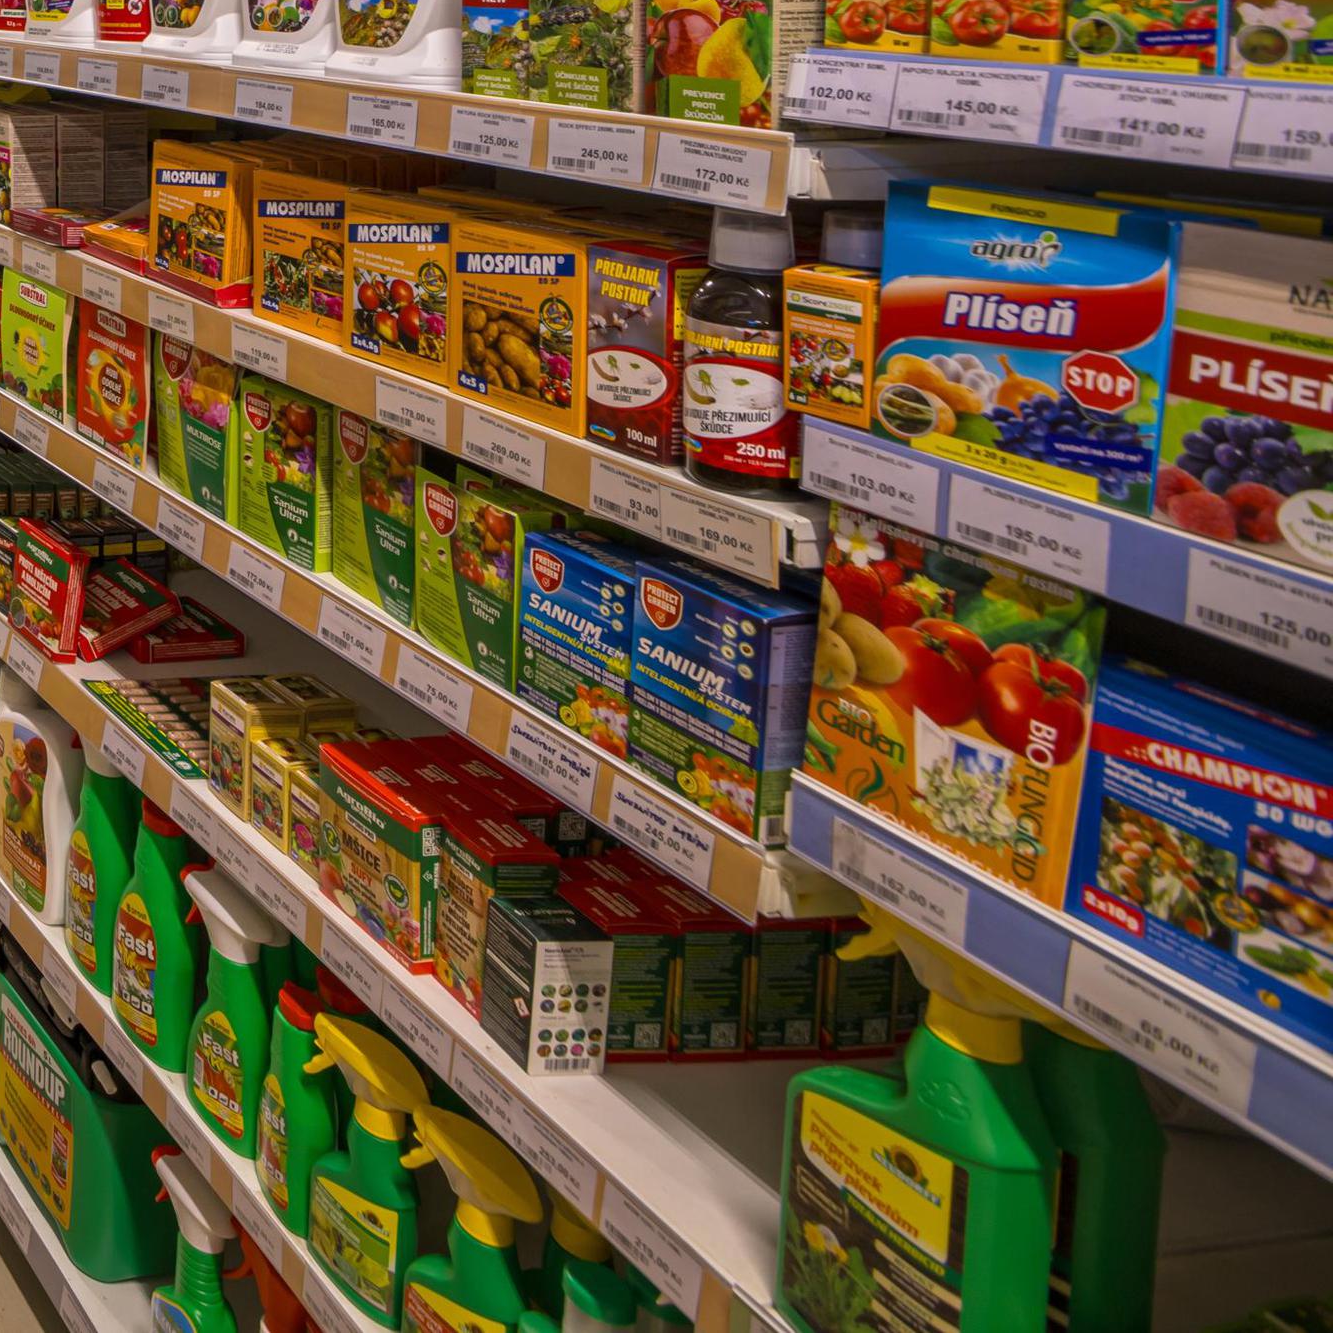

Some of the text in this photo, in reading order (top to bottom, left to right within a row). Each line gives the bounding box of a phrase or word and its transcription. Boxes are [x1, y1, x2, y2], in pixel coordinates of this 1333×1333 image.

[945, 99, 1020, 118] 145,00 Kč
[581, 148, 629, 163] 245,00 Kč
[161, 170, 218, 187] MOSPILAN
[695, 167, 751, 188] 172,00 Kč
[466, 253, 557, 275] MOSPILAN
[595, 257, 661, 288] PŘEDJARNÍ
[943, 290, 1077, 337] Plíseň
[1068, 366, 1133, 399] STOP
[736, 442, 786, 461] 250 ml
[466, 590, 502, 620] Sanium
[645, 583, 680, 606] PROTECT
[645, 595, 680, 618] GARDEN
[528, 592, 605, 644] SANIUM
[637, 635, 729, 693] SANIUM
[699, 681, 753, 714] SYSTEM
[837, 696, 873, 723] BIO
[817, 699, 907, 765] Garden
[1147, 741, 1317, 812] CHAMPION
[342, 830, 382, 875] MŠICE
[1084, 890, 1141, 934] 2x10g
[116, 926, 156, 962] Fast
[3, 1016, 68, 1108] ROUNDUP
